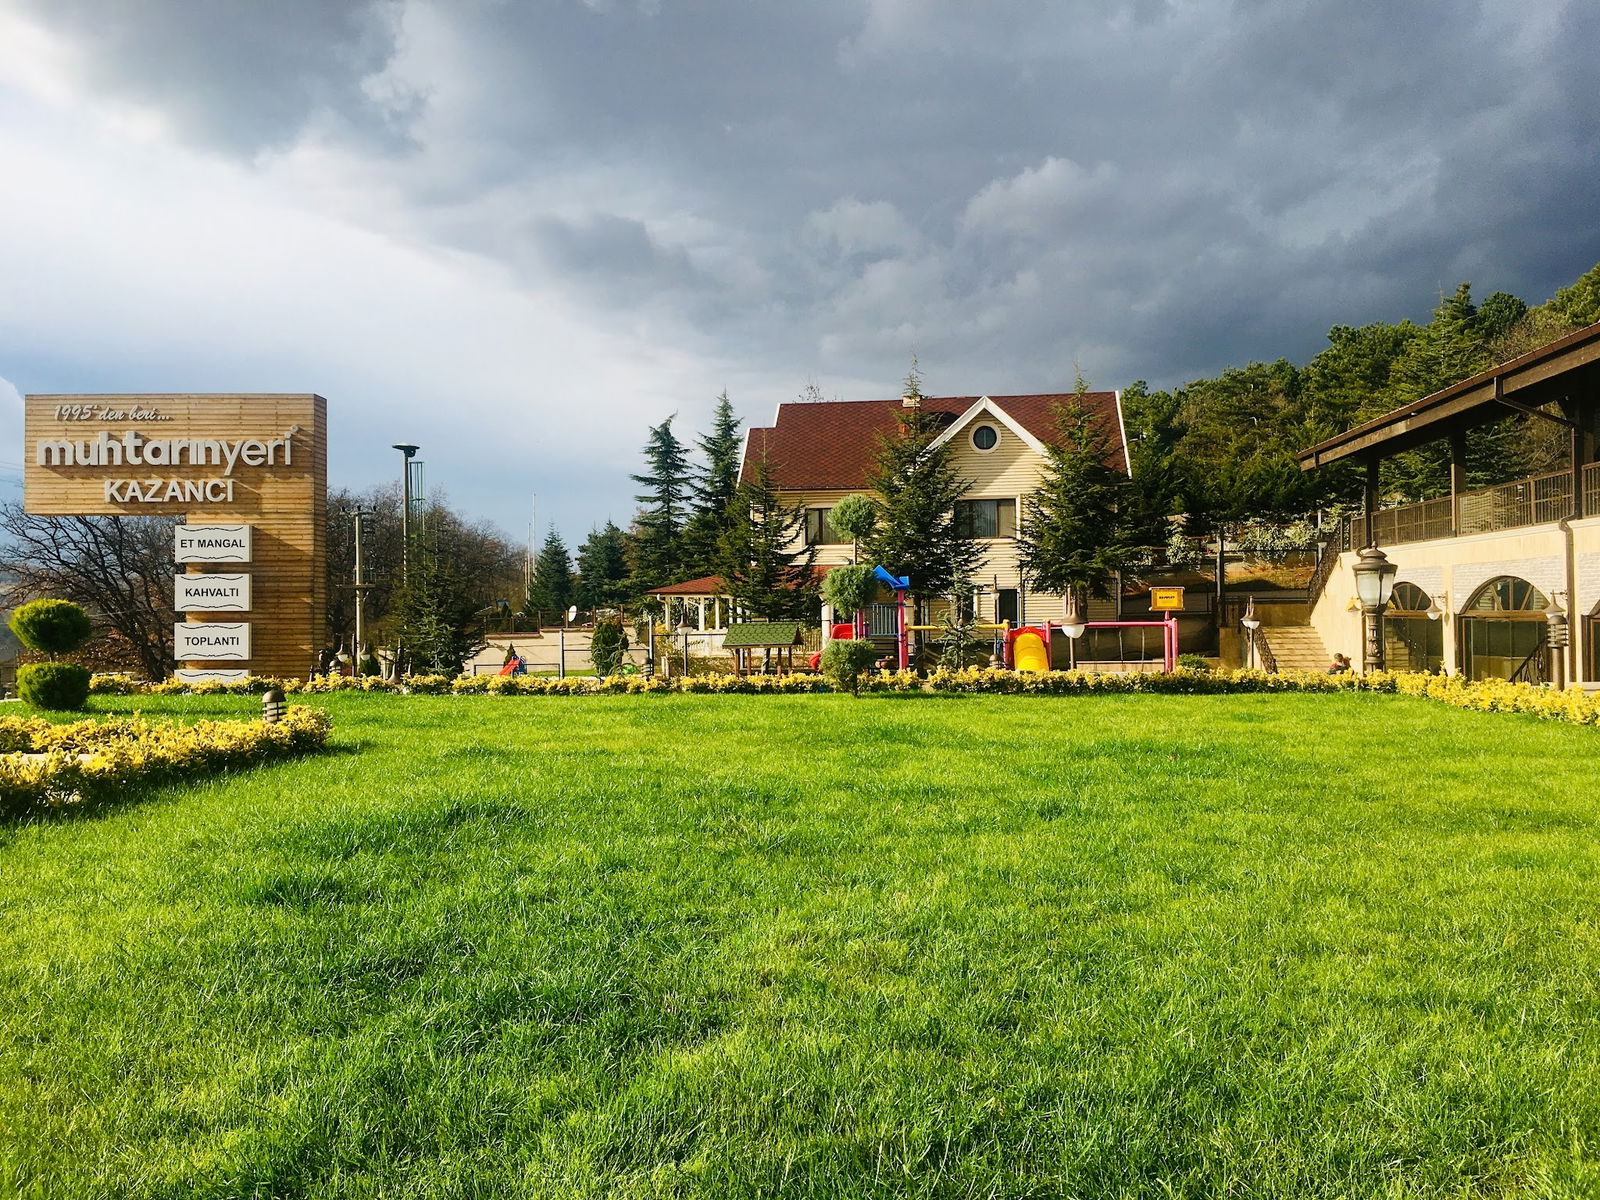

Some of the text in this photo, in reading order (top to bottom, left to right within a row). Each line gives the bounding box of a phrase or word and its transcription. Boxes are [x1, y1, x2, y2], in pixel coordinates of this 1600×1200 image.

[180, 539, 246, 548] ET MANGAL
[185, 588, 239, 597] KAHVALTI
[184, 636, 240, 646] TOPLANTI
